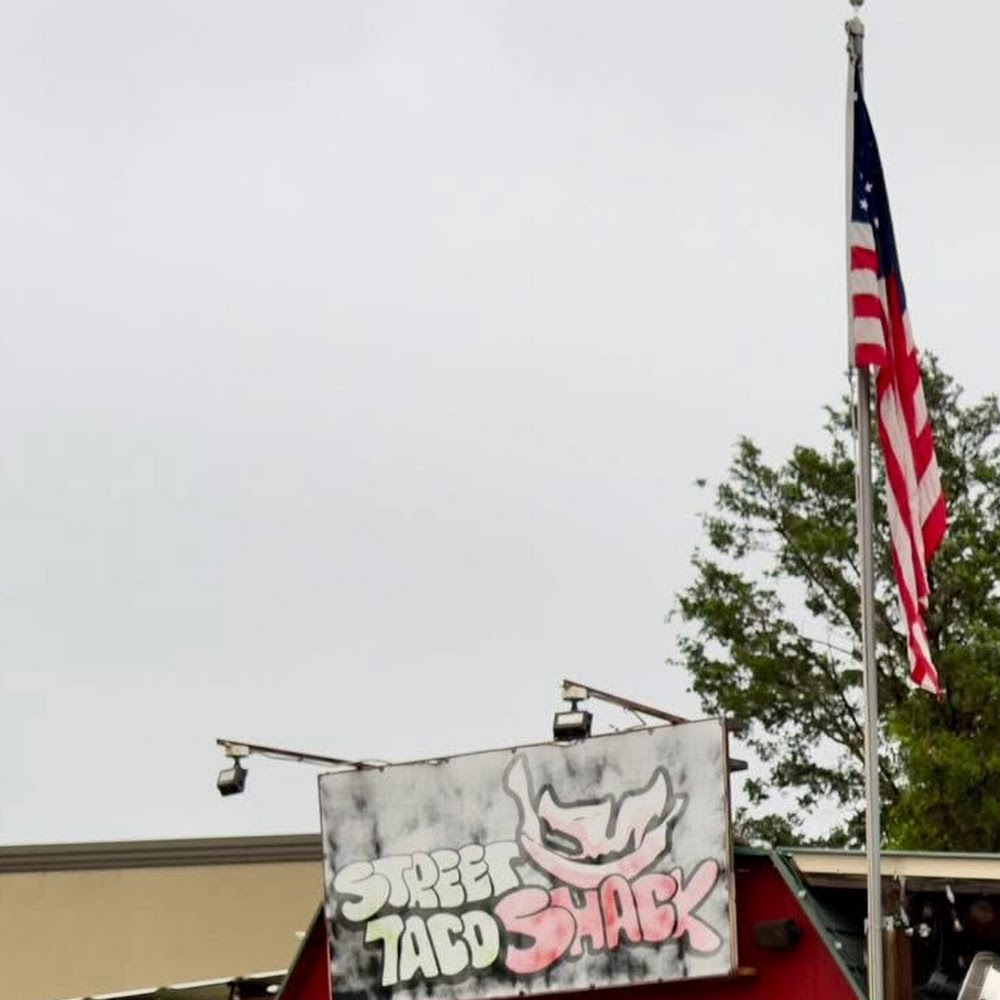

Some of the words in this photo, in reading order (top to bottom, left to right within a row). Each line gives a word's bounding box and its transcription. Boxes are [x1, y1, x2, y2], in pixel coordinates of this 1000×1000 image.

[334, 841, 521, 922] STREET
[365, 909, 501, 987] TACO
[495, 858, 722, 975] SHACK
